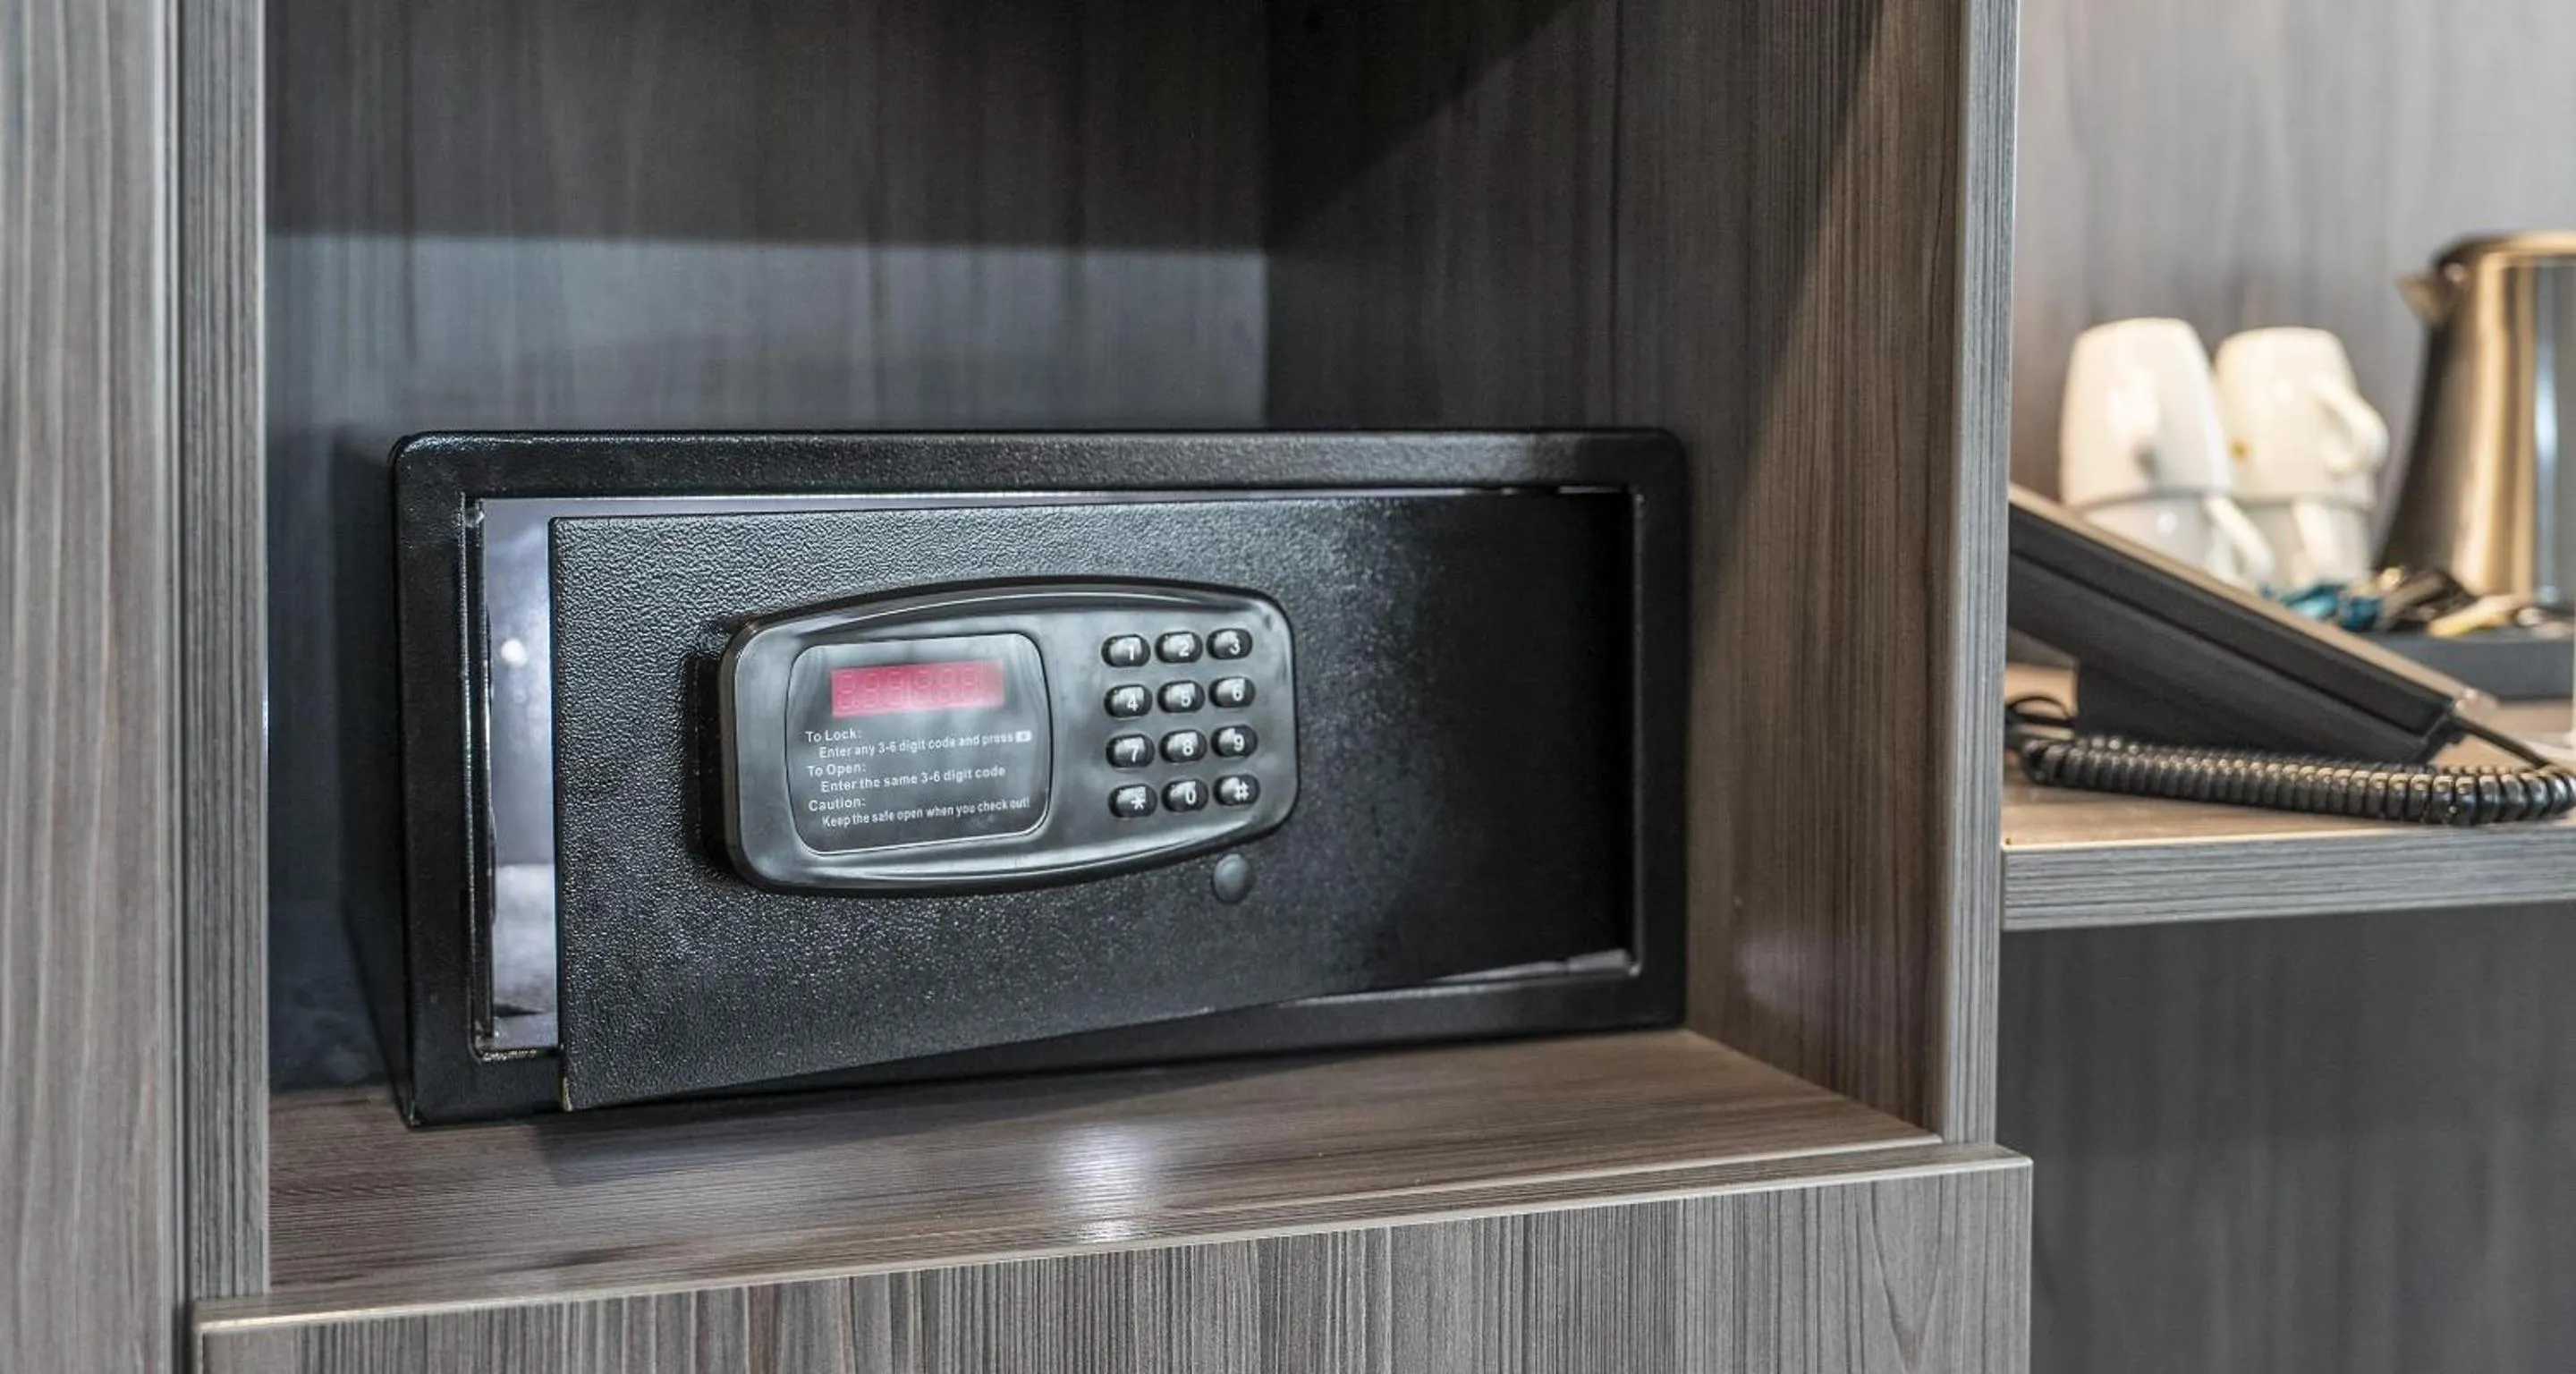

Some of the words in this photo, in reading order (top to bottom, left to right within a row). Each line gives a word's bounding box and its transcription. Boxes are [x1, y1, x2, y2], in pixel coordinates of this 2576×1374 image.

[1127, 645, 1135, 661] 1
[1178, 641, 1190, 657] 2
[1228, 639, 1241, 655] 3
[1126, 694, 1139, 712] 4
[1180, 691, 1192, 708] 5
[1232, 685, 1243, 702] 6
[805, 731, 822, 742] To
[825, 727, 862, 742] Lock:
[818, 746, 852, 759] Enter
[854, 743, 876, 757] any
[878, 741, 897, 754] 3-6
[899, 739, 926, 753] digit
[928, 735, 955, 750] code
[958, 734, 980, 747] and
[982, 733, 1014, 747] press
[1129, 746, 1140, 762] 7
[1182, 740, 1194, 757] 8
[1233, 734, 1244, 751] 9
[807, 765, 824, 777] To
[826, 763, 867, 777] Open:
[821, 779, 857, 793] Enter
[860, 776, 880, 789] the
[883, 775, 918, 787] same
[920, 770, 941, 784] 3-6
[944, 768, 972, 783] digit
[974, 765, 1005, 779] code
[808, 796, 867, 811] Caution:
[1184, 789, 1197, 805] 0
[1234, 781, 1250, 801] #
[822, 815, 851, 828] Keep
[852, 812, 870, 825] the
[872, 810, 894, 823] safe
[896, 808, 923, 822] open
[926, 805, 954, 818] when
[956, 805, 976, 818] you
[977, 800, 1008, 812] check
[1009, 796, 1030, 810] out!
